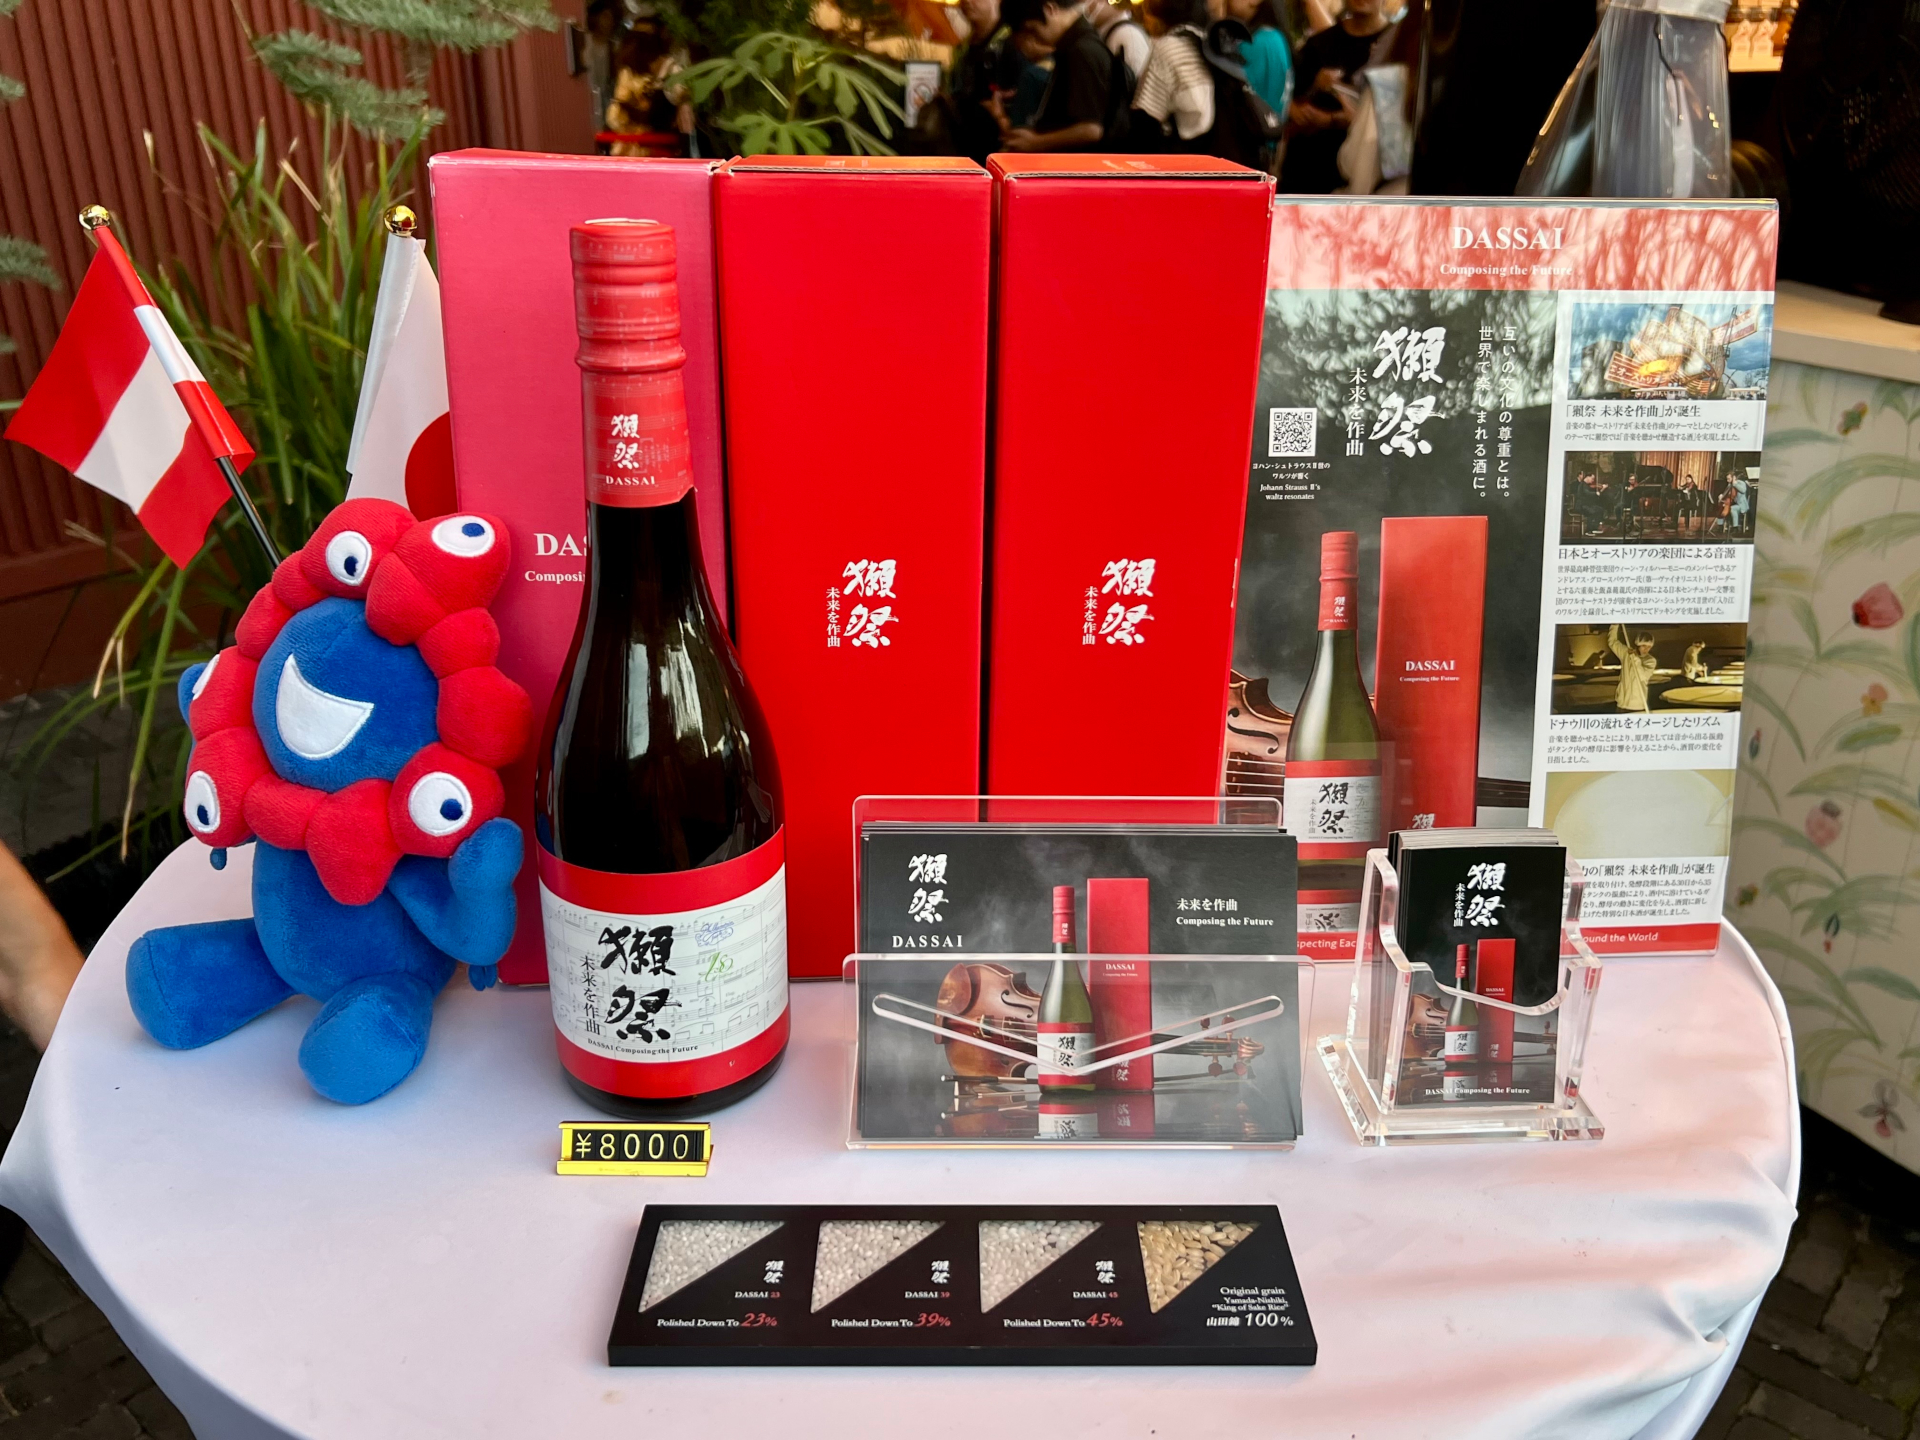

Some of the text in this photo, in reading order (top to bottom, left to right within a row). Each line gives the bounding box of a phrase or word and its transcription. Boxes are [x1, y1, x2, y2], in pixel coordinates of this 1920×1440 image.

[1452, 226, 1564, 250] DASSAI
[1440, 264, 1573, 277] Composing the Future
[1368, 326, 1446, 458] 獺祭
[1346, 367, 1367, 456] 未来を作曲
[1472, 326, 1493, 498] 世界で楽しまれる酒に。
[1497, 326, 1517, 498] 互いの文化の尊重とは。
[1600, 404, 1701, 418] 未来を作曲」が誕生
[611, 414, 642, 469] 獺祭
[605, 475, 655, 485] DASSAI
[1260, 484, 1283, 492] Johann
[533, 533, 587, 556] DA
[1558, 547, 1736, 560] 日本とオーストリアの楽団による音源
[524, 570, 585, 584] Composi
[842, 559, 899, 648] 獺祭
[1098, 558, 1156, 646] 獺祭
[826, 587, 840, 647] 未来を作曲
[1082, 586, 1098, 645] 未来を作曲
[1405, 660, 1455, 671] DASSAI
[1550, 716, 1721, 730] ドナウ川の流れをイメージしたリズム
[908, 853, 949, 924] 獺祭
[1465, 862, 1506, 927] 獺祭
[1176, 898, 1237, 911] 未来を作曲
[1454, 883, 1465, 927] 未来を作曲
[1176, 916, 1274, 927] Composing the Future
[892, 934, 962, 947] DASSAI
[1610, 934, 1626, 942] the
[1628, 932, 1659, 941] World
[1105, 963, 1135, 971] DASSAI
[598, 925, 682, 1043] 獺祭
[580, 955, 600, 1035] 未来を作曲
[588, 1038, 698, 1055] DASSAI Composing the Future
[1454, 1087, 1492, 1095] Composing
[575, 1133, 689, 1159] ¥8000
[734, 1290, 768, 1298] DASSAI
[904, 1290, 938, 1298] DASSAI
[1072, 1290, 1106, 1298] DASSAI
[1220, 1286, 1285, 1296] Original grain
[657, 1312, 778, 1327] Polished Down To 23%
[831, 1312, 951, 1327] Polished Down To 39%
[1003, 1312, 1123, 1327] Polished Down To 45%
